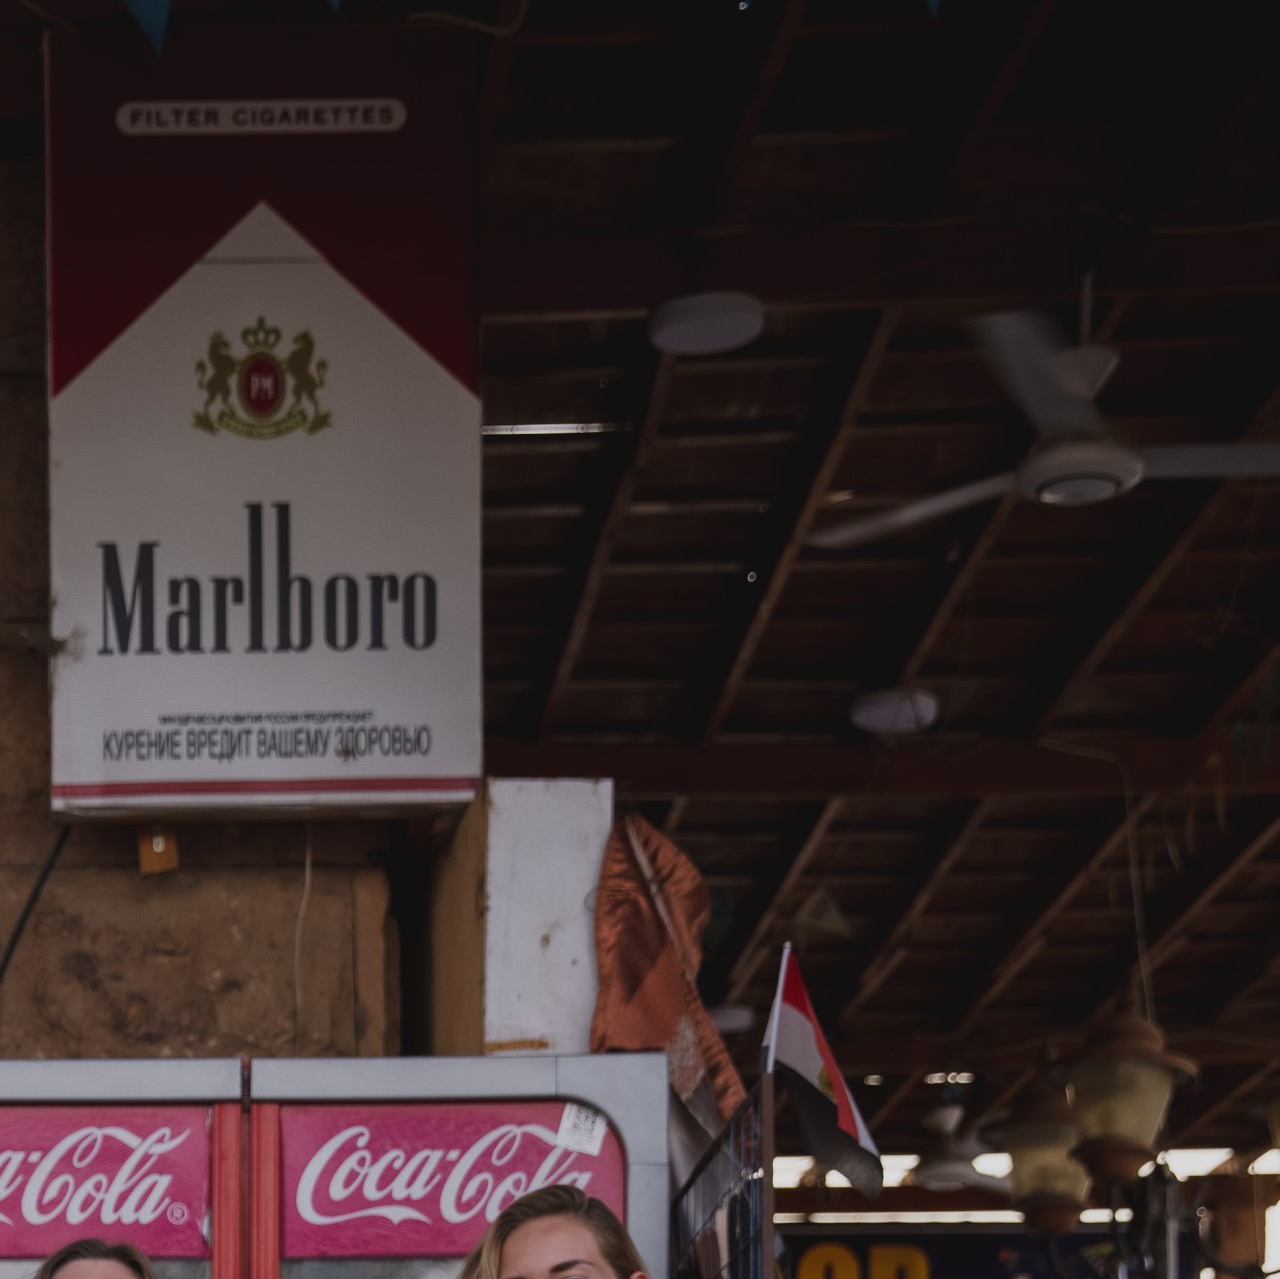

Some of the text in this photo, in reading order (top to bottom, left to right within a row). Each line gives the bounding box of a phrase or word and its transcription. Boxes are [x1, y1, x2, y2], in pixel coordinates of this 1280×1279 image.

[129, 104, 394, 128] FILTER CIGARETTES
[96, 502, 437, 656] Marlboro
[102, 724, 433, 764] КУРЕНИЕ ВРЕДИТ ВАШЕМУ ЗДОРОВЬЮ
